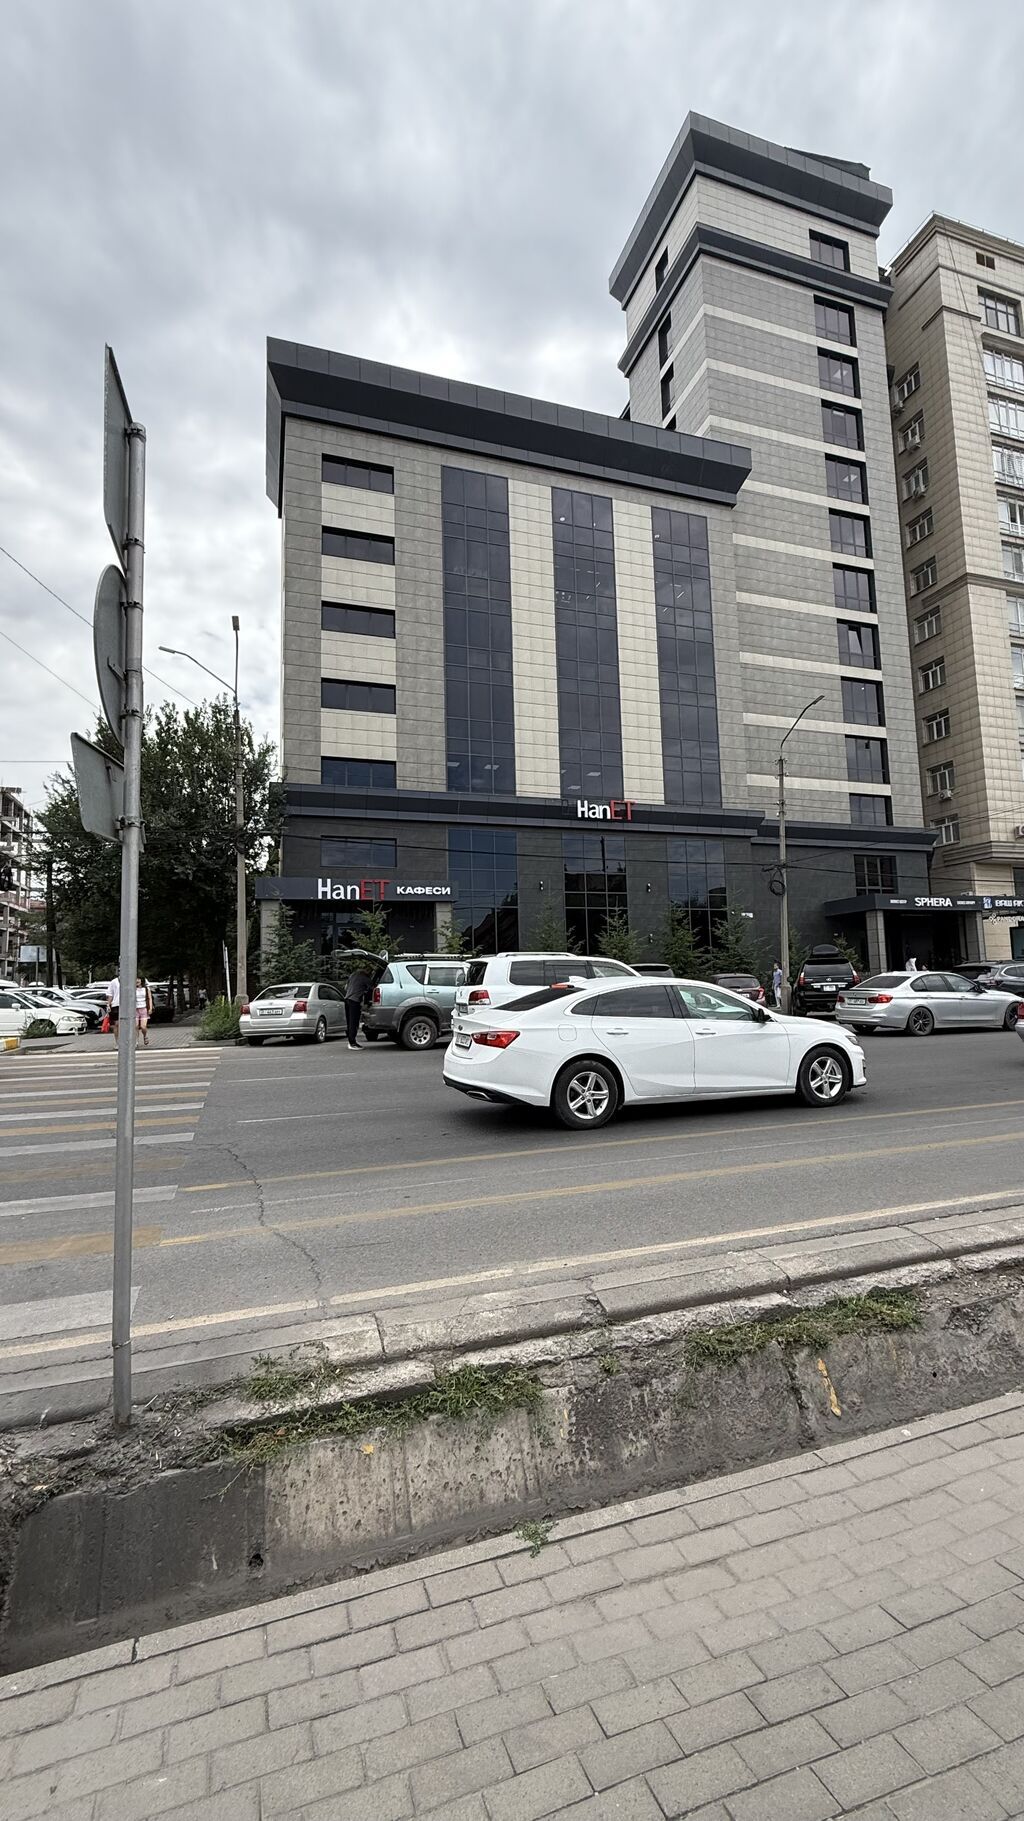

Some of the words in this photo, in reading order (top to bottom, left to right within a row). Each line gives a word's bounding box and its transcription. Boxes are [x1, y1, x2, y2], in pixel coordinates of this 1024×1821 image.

[577, 799, 637, 821] HanET
[317, 878, 391, 901] HanET
[396, 886, 451, 895] КАФЕСИ
[914, 897, 953, 907] SPHERA
